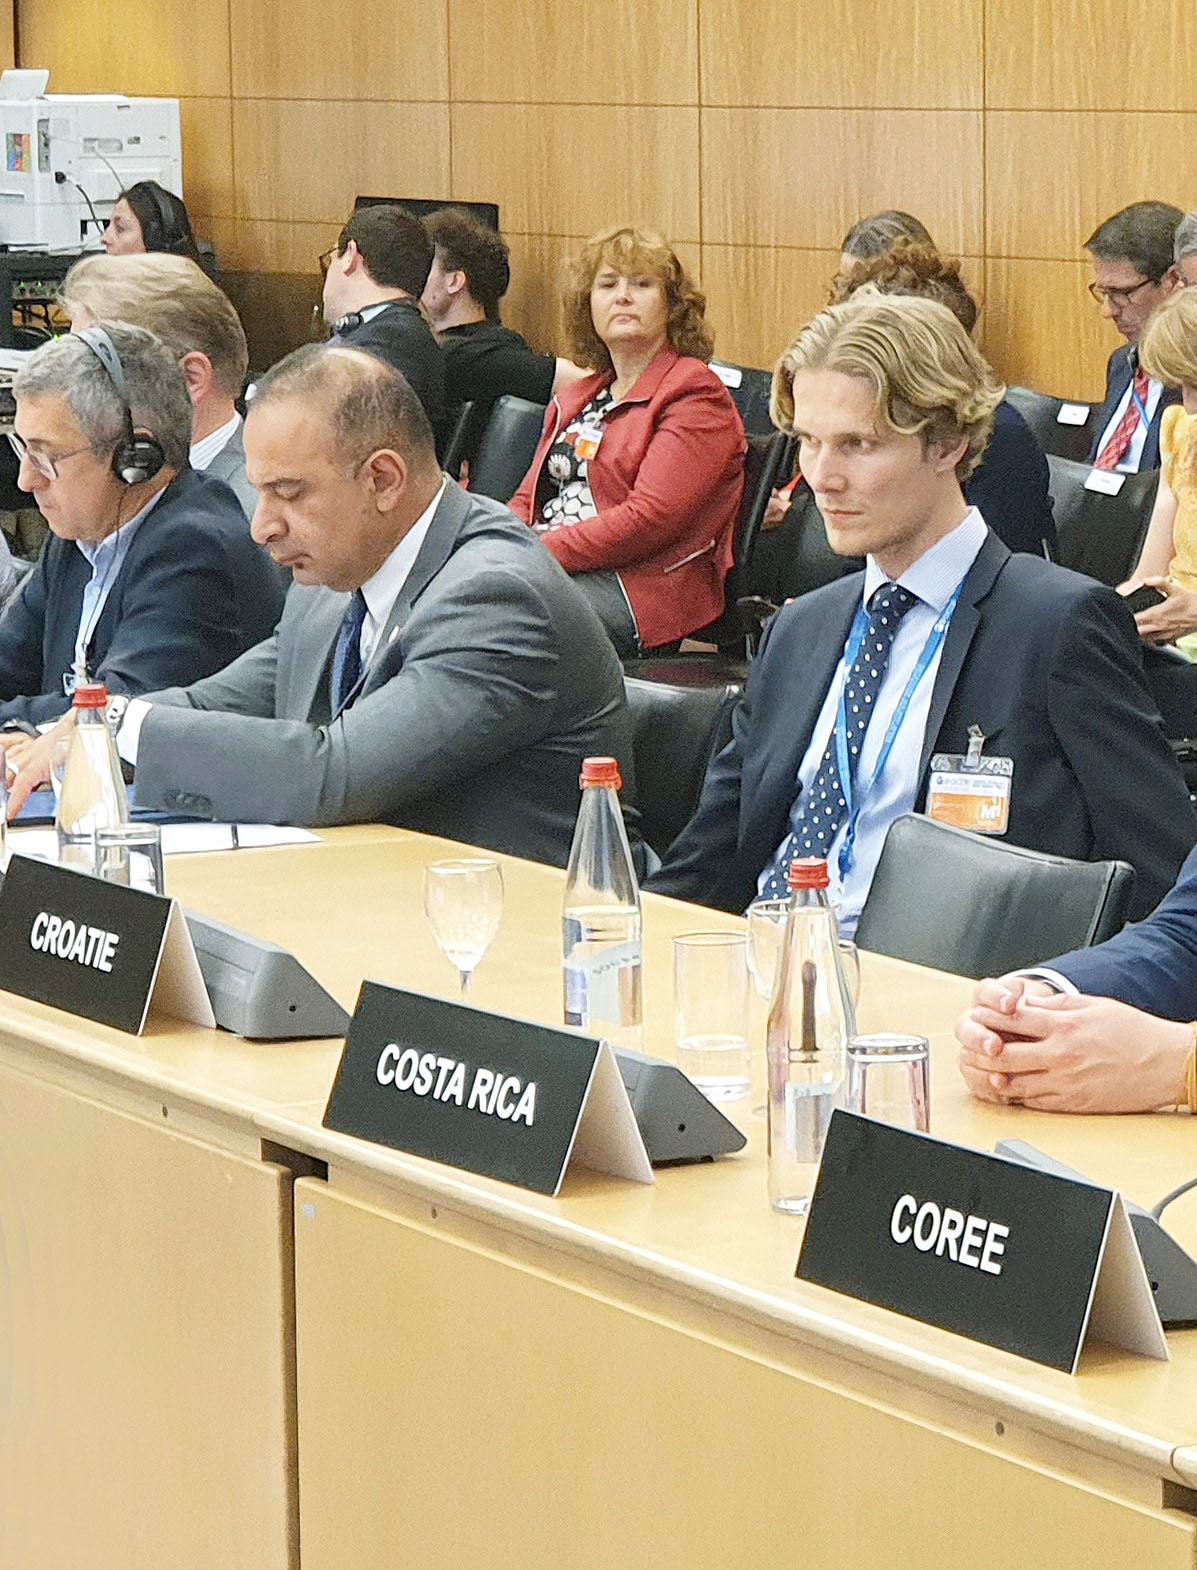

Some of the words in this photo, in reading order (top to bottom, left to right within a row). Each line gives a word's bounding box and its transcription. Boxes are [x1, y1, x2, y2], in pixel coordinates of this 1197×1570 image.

[30, 911, 119, 973] CROATIE
[376, 1043, 466, 1106] COSTA
[467, 1067, 538, 1126] RICA
[890, 1194, 1010, 1275] COREE
